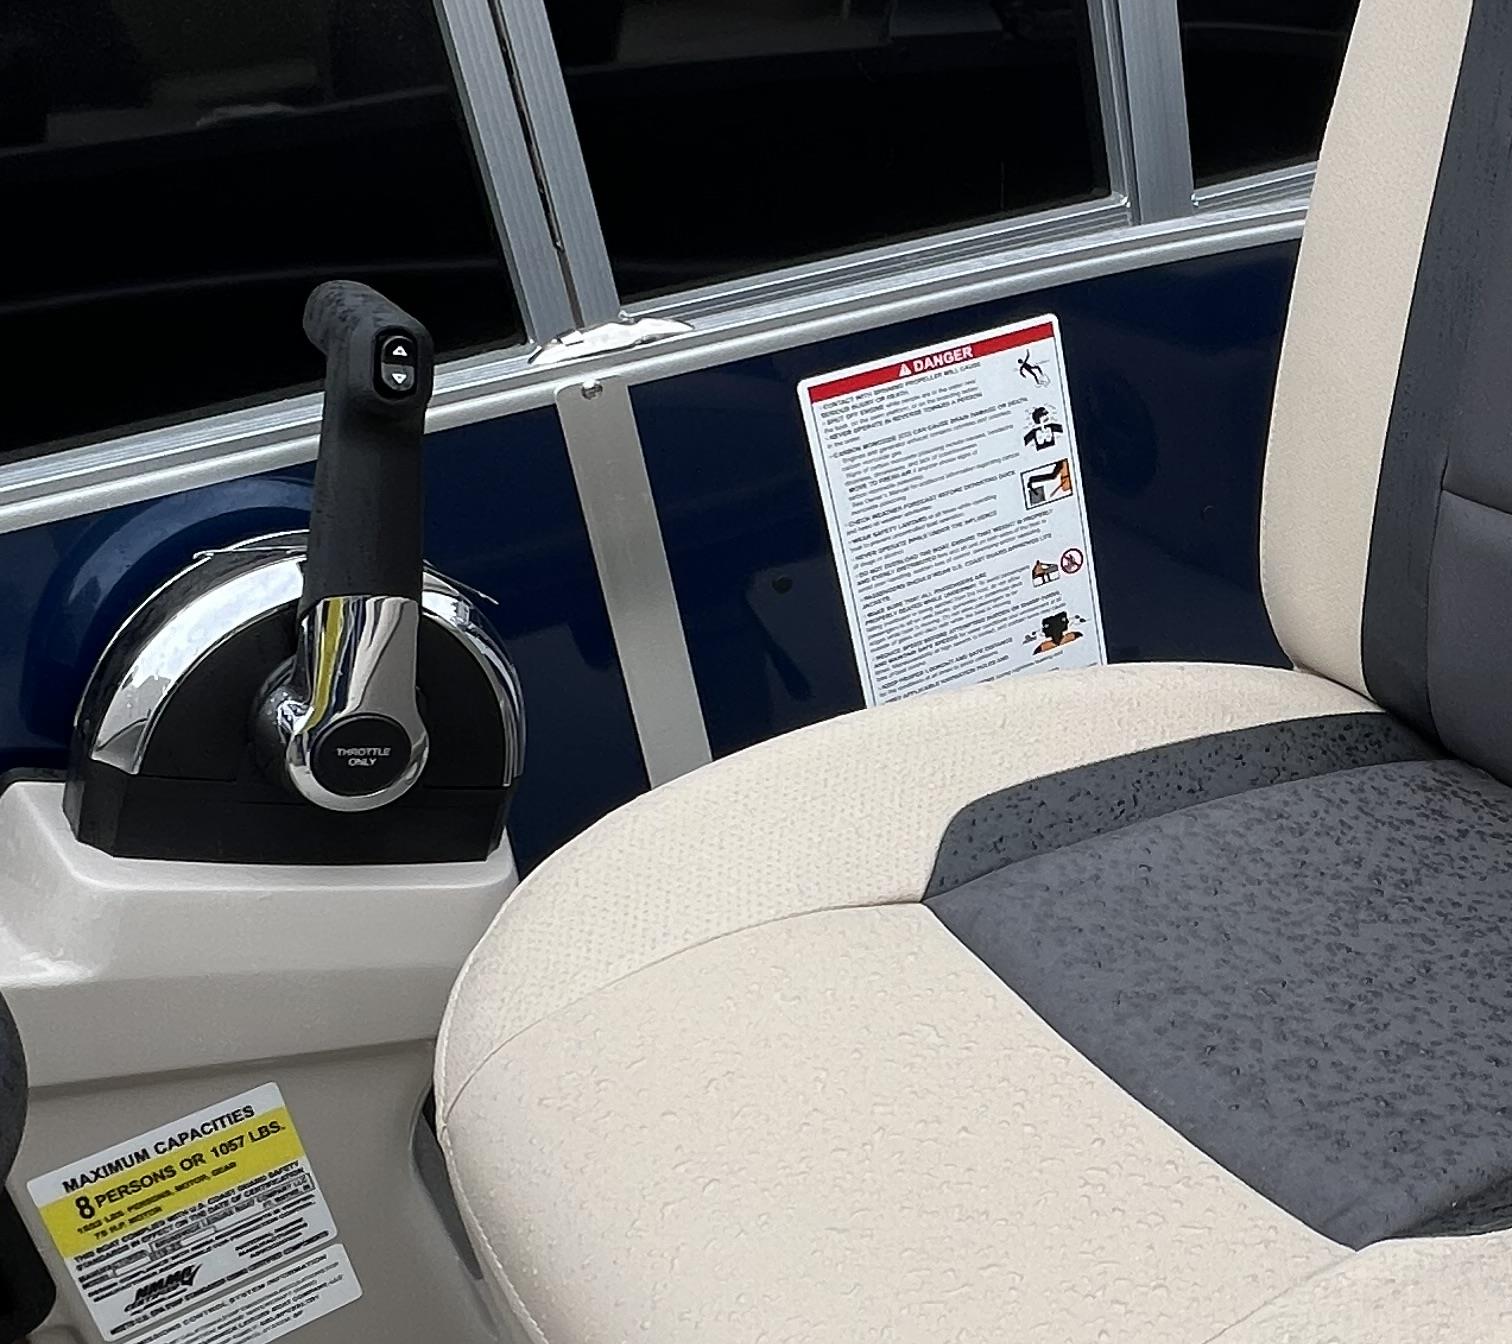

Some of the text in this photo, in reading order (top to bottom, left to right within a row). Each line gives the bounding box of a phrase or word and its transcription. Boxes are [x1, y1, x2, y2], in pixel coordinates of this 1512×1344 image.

[913, 346, 973, 372] DANGER
[336, 747, 391, 756] THROTTLE
[348, 758, 377, 766] ONLY
[62, 1105, 255, 1193] MAXIMUM CAPACITIES
[75, 1121, 285, 1219] 8 PERSONS OR 1057 LBS.
